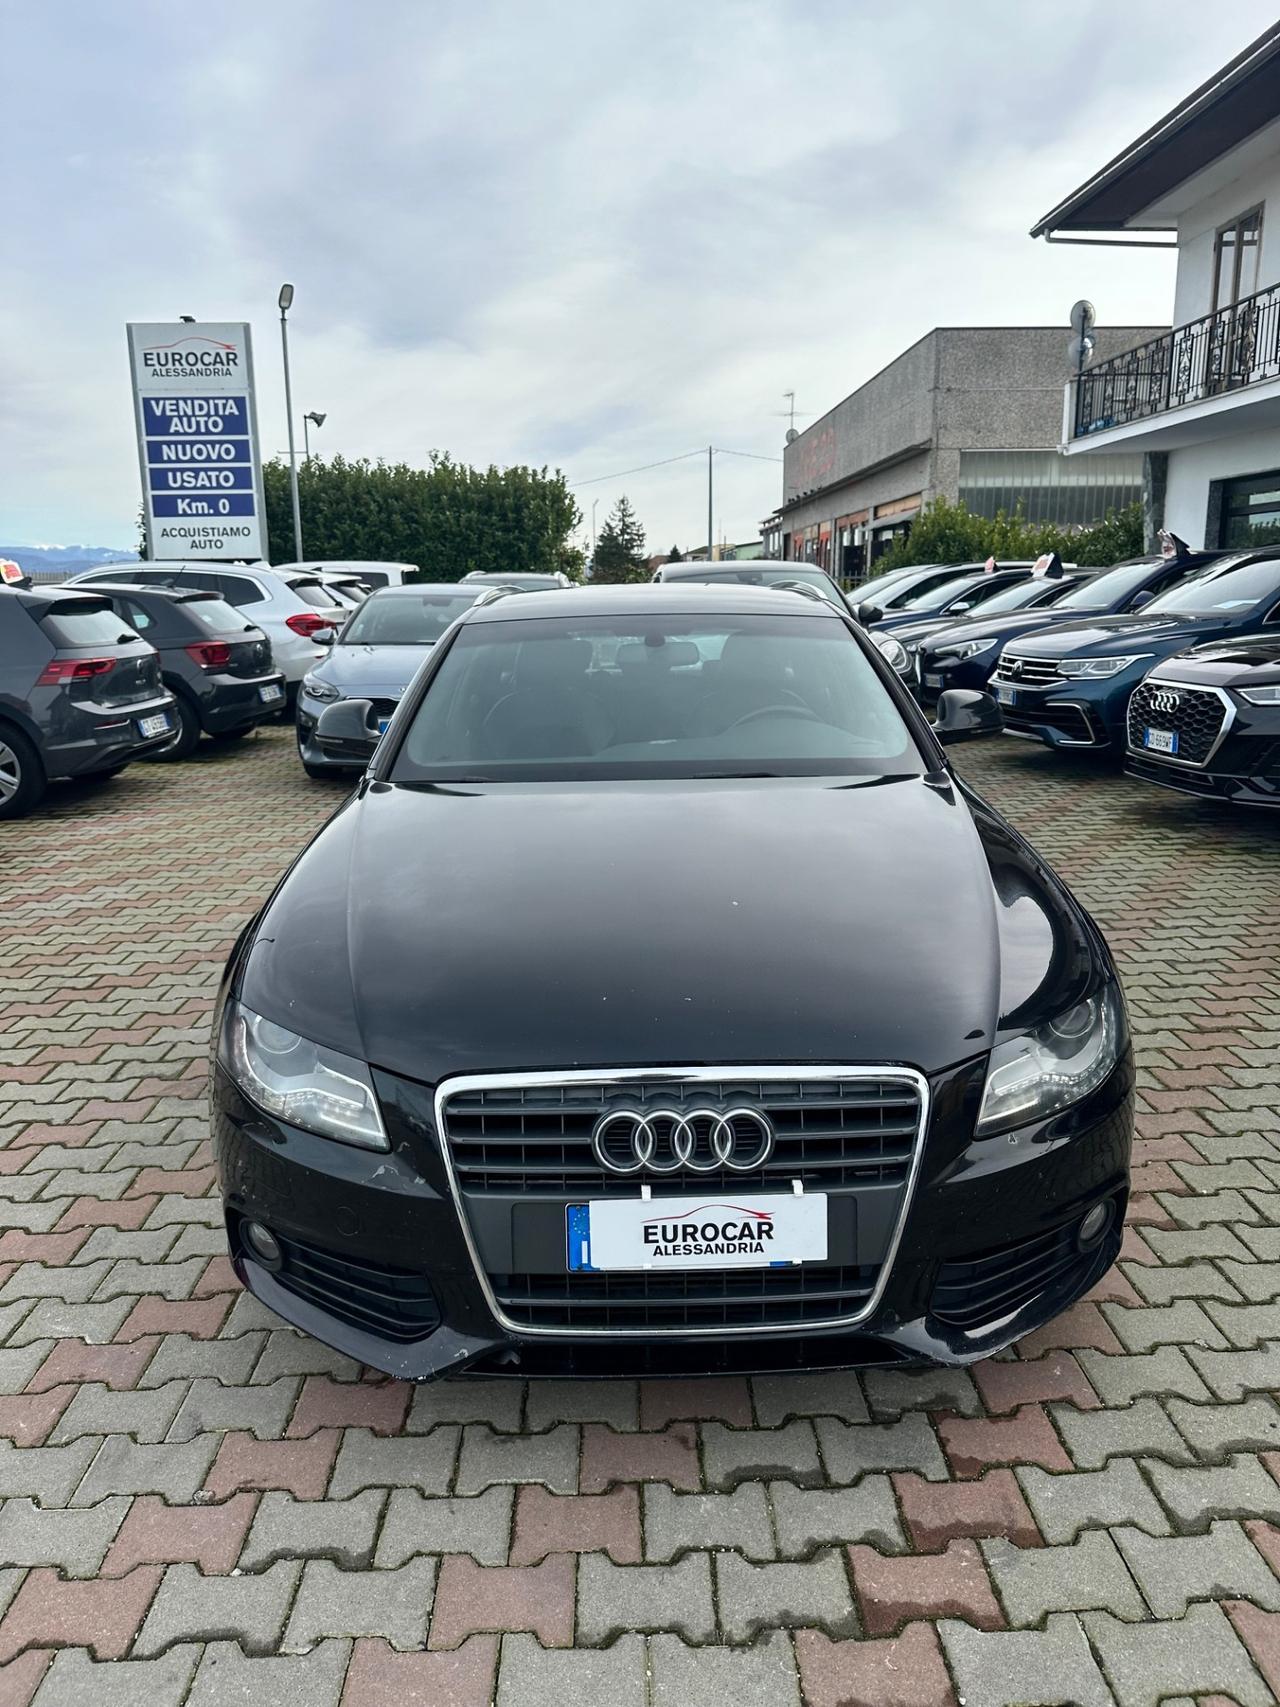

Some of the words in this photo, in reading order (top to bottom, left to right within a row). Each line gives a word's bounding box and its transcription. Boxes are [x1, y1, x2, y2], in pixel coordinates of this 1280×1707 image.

[144, 352, 238, 367] EUROCAR
[152, 367, 232, 377] ALESSANDRIA
[151, 399, 239, 416] VENDITA
[169, 416, 224, 433] AUTO
[162, 444, 235, 460] NUOVO
[168, 471, 235, 487] USATO
[177, 499, 214, 514] Km.
[218, 498, 230, 514] 0
[161, 527, 251, 537] ACQUISTIAMO
[190, 539, 224, 549] AUTO
[643, 1222, 774, 1244] EUROCAR
[653, 1242, 764, 1257] ALESSANDRIA
